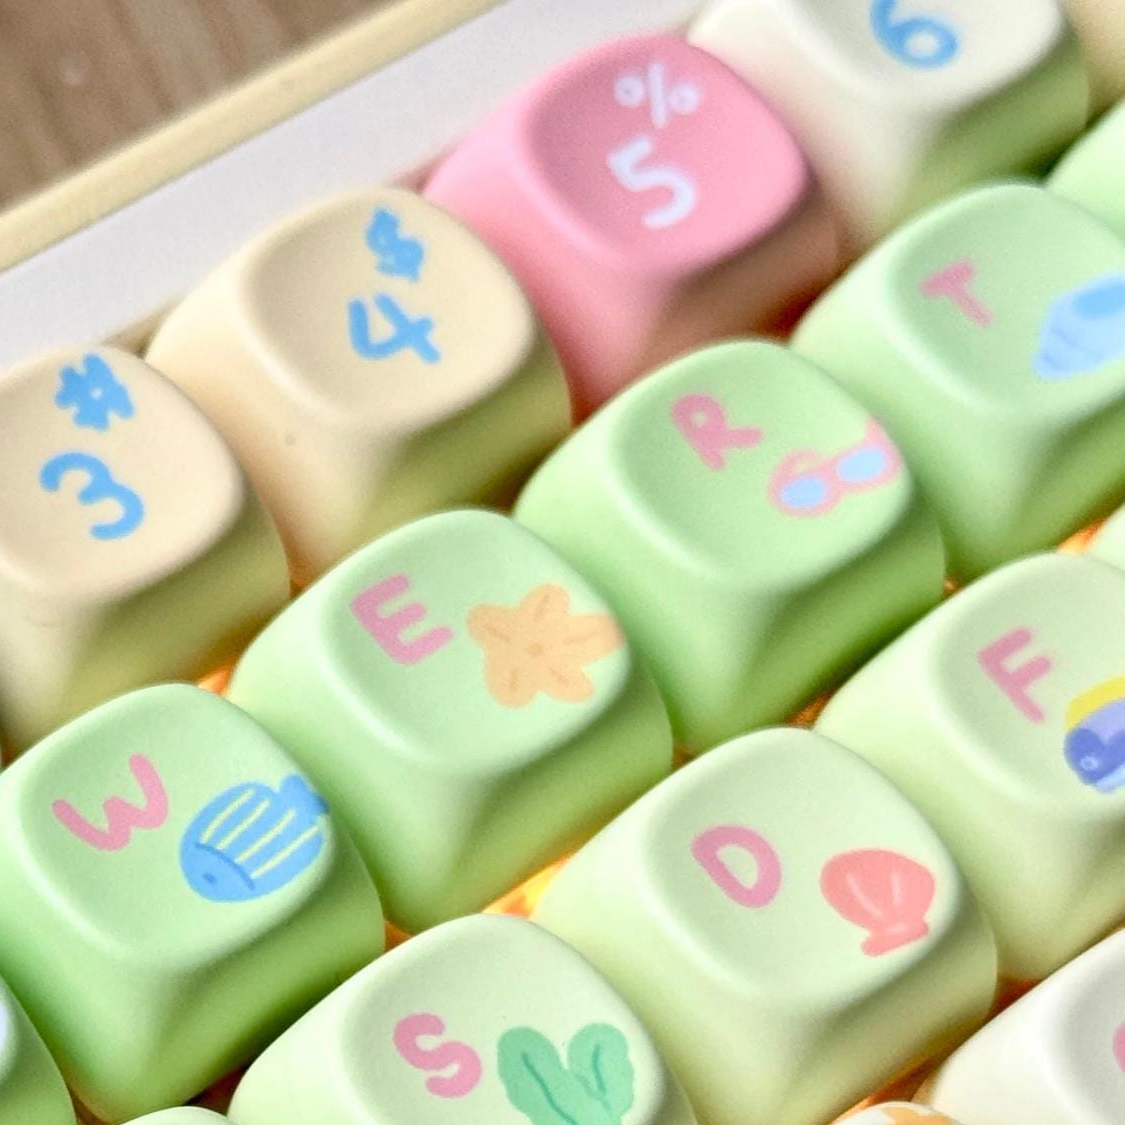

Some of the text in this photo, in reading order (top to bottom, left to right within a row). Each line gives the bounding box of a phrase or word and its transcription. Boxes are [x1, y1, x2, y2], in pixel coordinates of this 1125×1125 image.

[871, 0, 961, 70] 6
[613, 60, 701, 128] %
[608, 136, 698, 229] 5
[348, 293, 441, 364] 4
[919, 258, 993, 326] T
[672, 393, 764, 471] R
[38, 452, 146, 541] 3
[351, 573, 454, 666] E
[977, 626, 1053, 724] F
[52, 753, 169, 851] W
[690, 824, 782, 909] D
[392, 1012, 483, 1099] S
